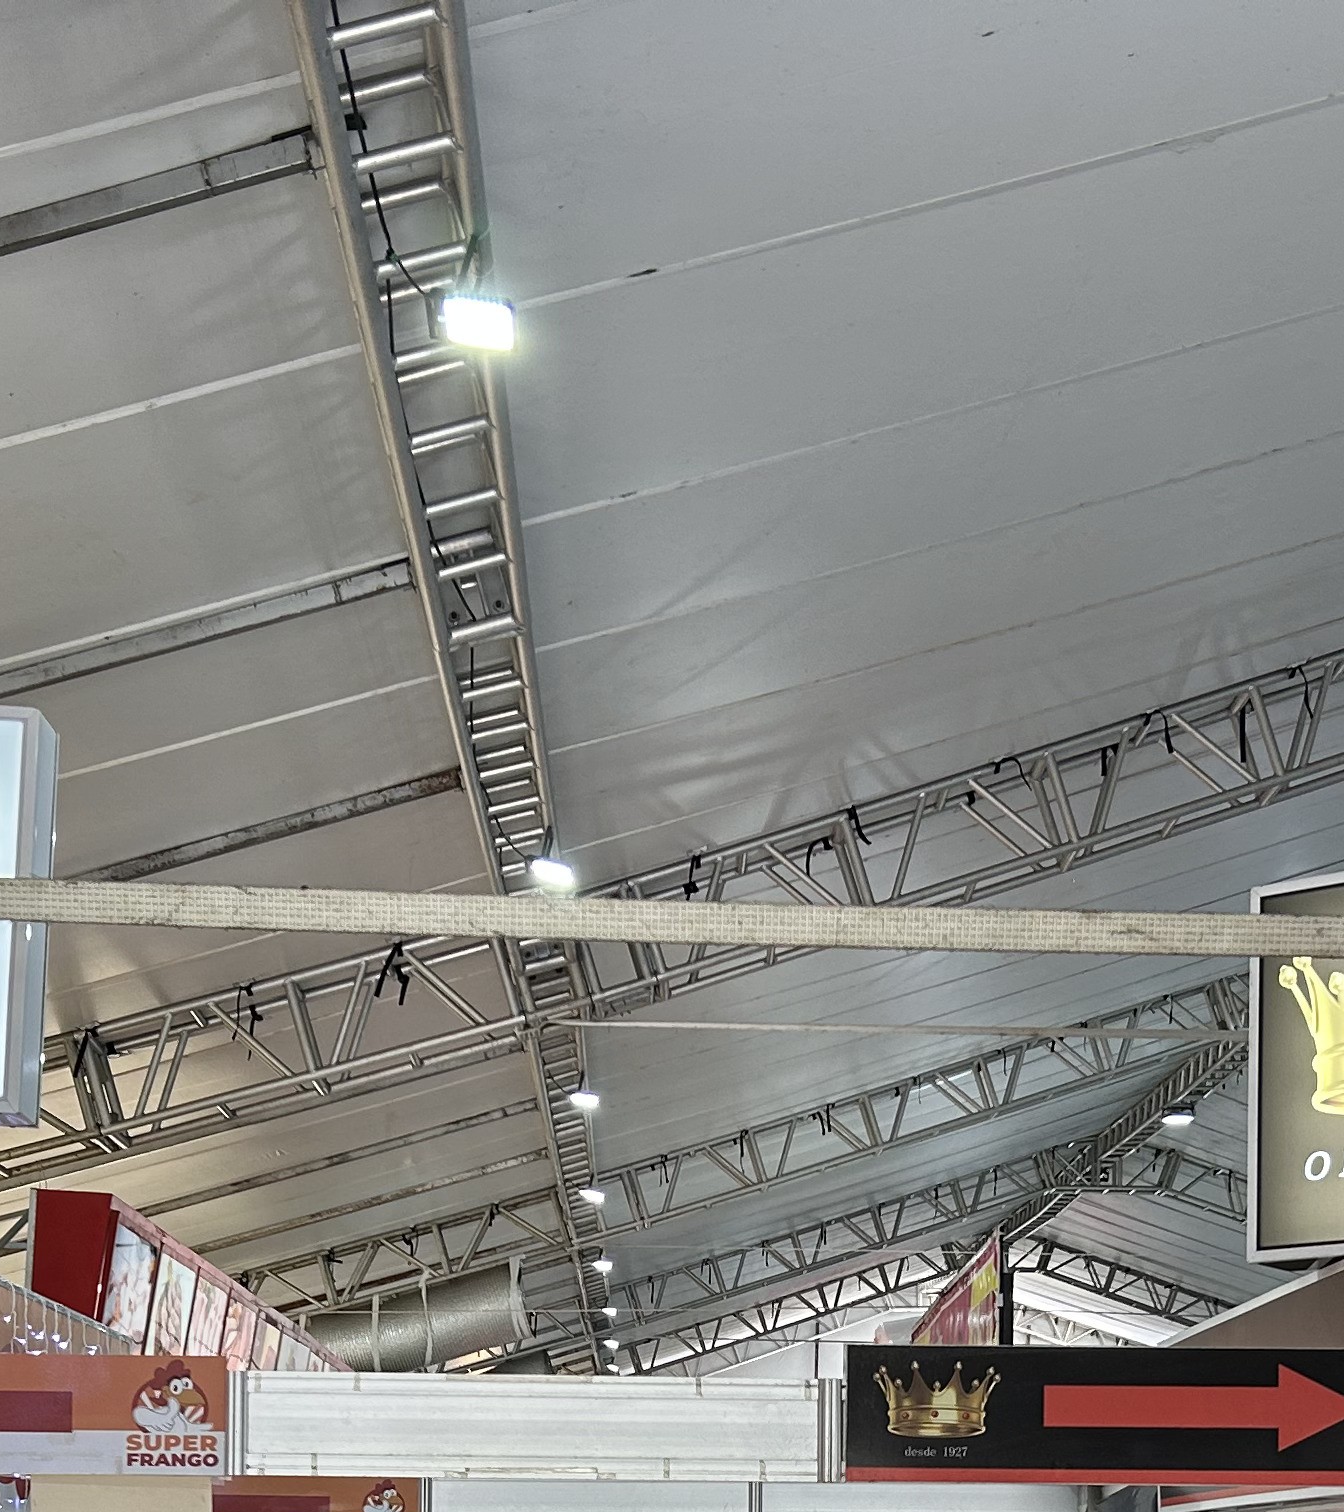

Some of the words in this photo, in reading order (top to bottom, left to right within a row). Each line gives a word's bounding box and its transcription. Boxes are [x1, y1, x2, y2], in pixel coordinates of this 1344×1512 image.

[1304, 1151, 1331, 1181] O
[126, 1434, 217, 1452] SUPER
[904, 1446, 936, 1457] desde
[943, 1446, 968, 1458] 1927
[126, 1453, 219, 1468] FRANGO
